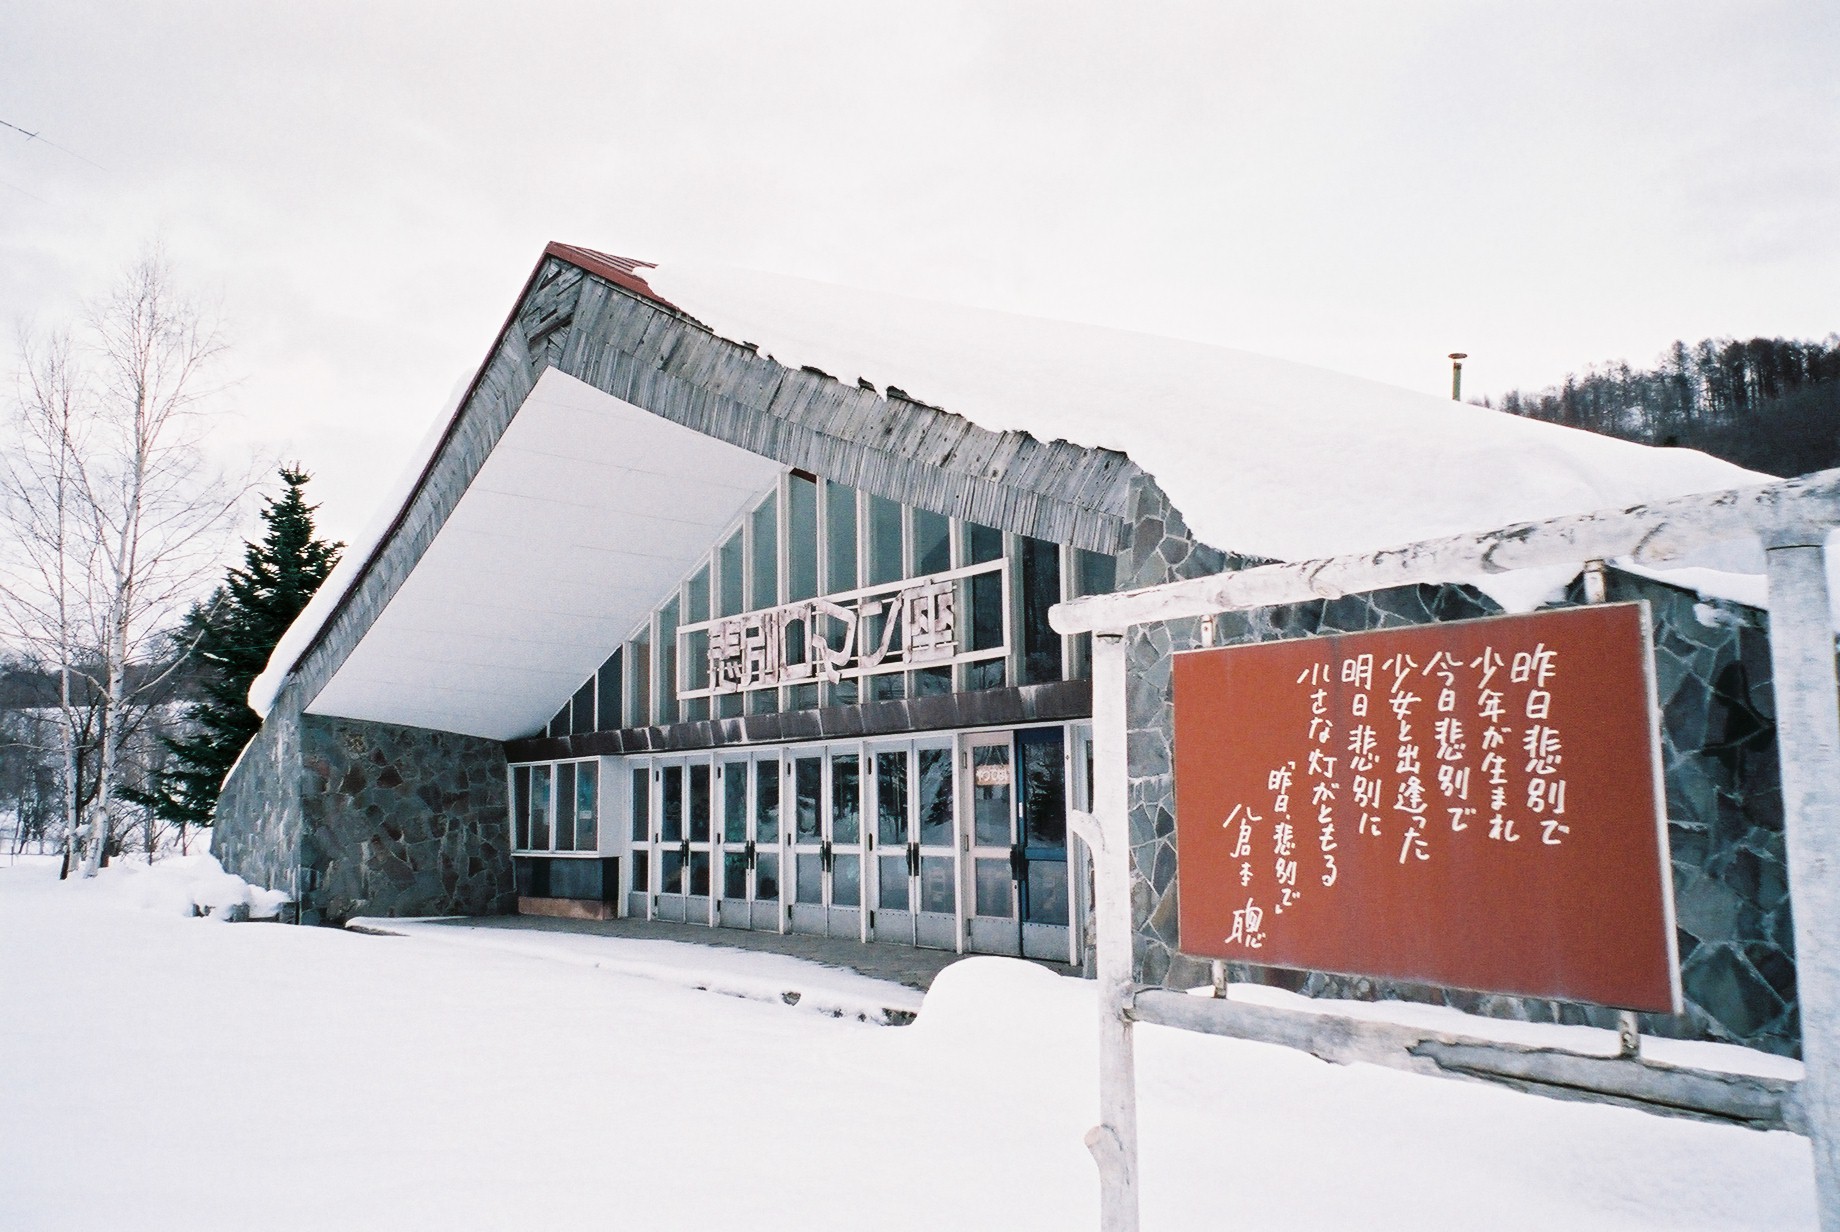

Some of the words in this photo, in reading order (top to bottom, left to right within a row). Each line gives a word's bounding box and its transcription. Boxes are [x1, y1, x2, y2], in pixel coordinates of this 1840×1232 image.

[707, 579, 955, 693] 悲別ロマン座
[1297, 662, 1339, 888] 小さな灯がともる
[1341, 653, 1383, 837] 明日悲別に
[1382, 652, 1431, 865] 少女と出逢った
[1422, 650, 1478, 832] 今日悲別で
[1470, 645, 1521, 842] 少年が生まれ
[1509, 642, 1571, 846] 昨日悲別で
